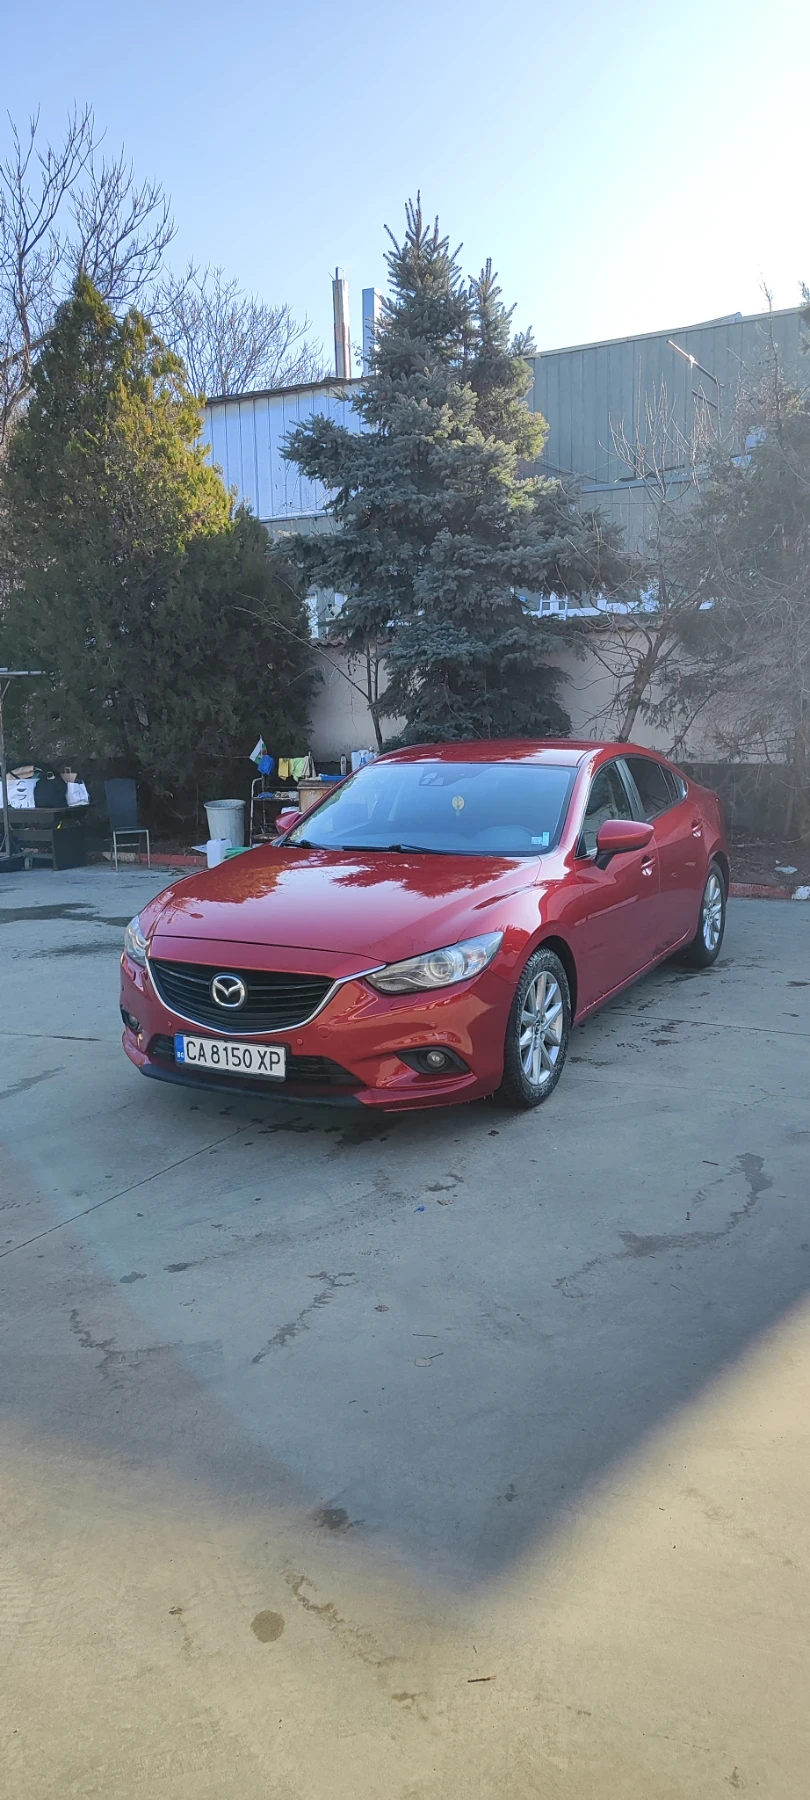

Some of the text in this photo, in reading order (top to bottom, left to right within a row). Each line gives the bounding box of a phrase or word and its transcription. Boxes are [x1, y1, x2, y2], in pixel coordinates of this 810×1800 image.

[186, 1041, 280, 1071] CA 8150 XP
